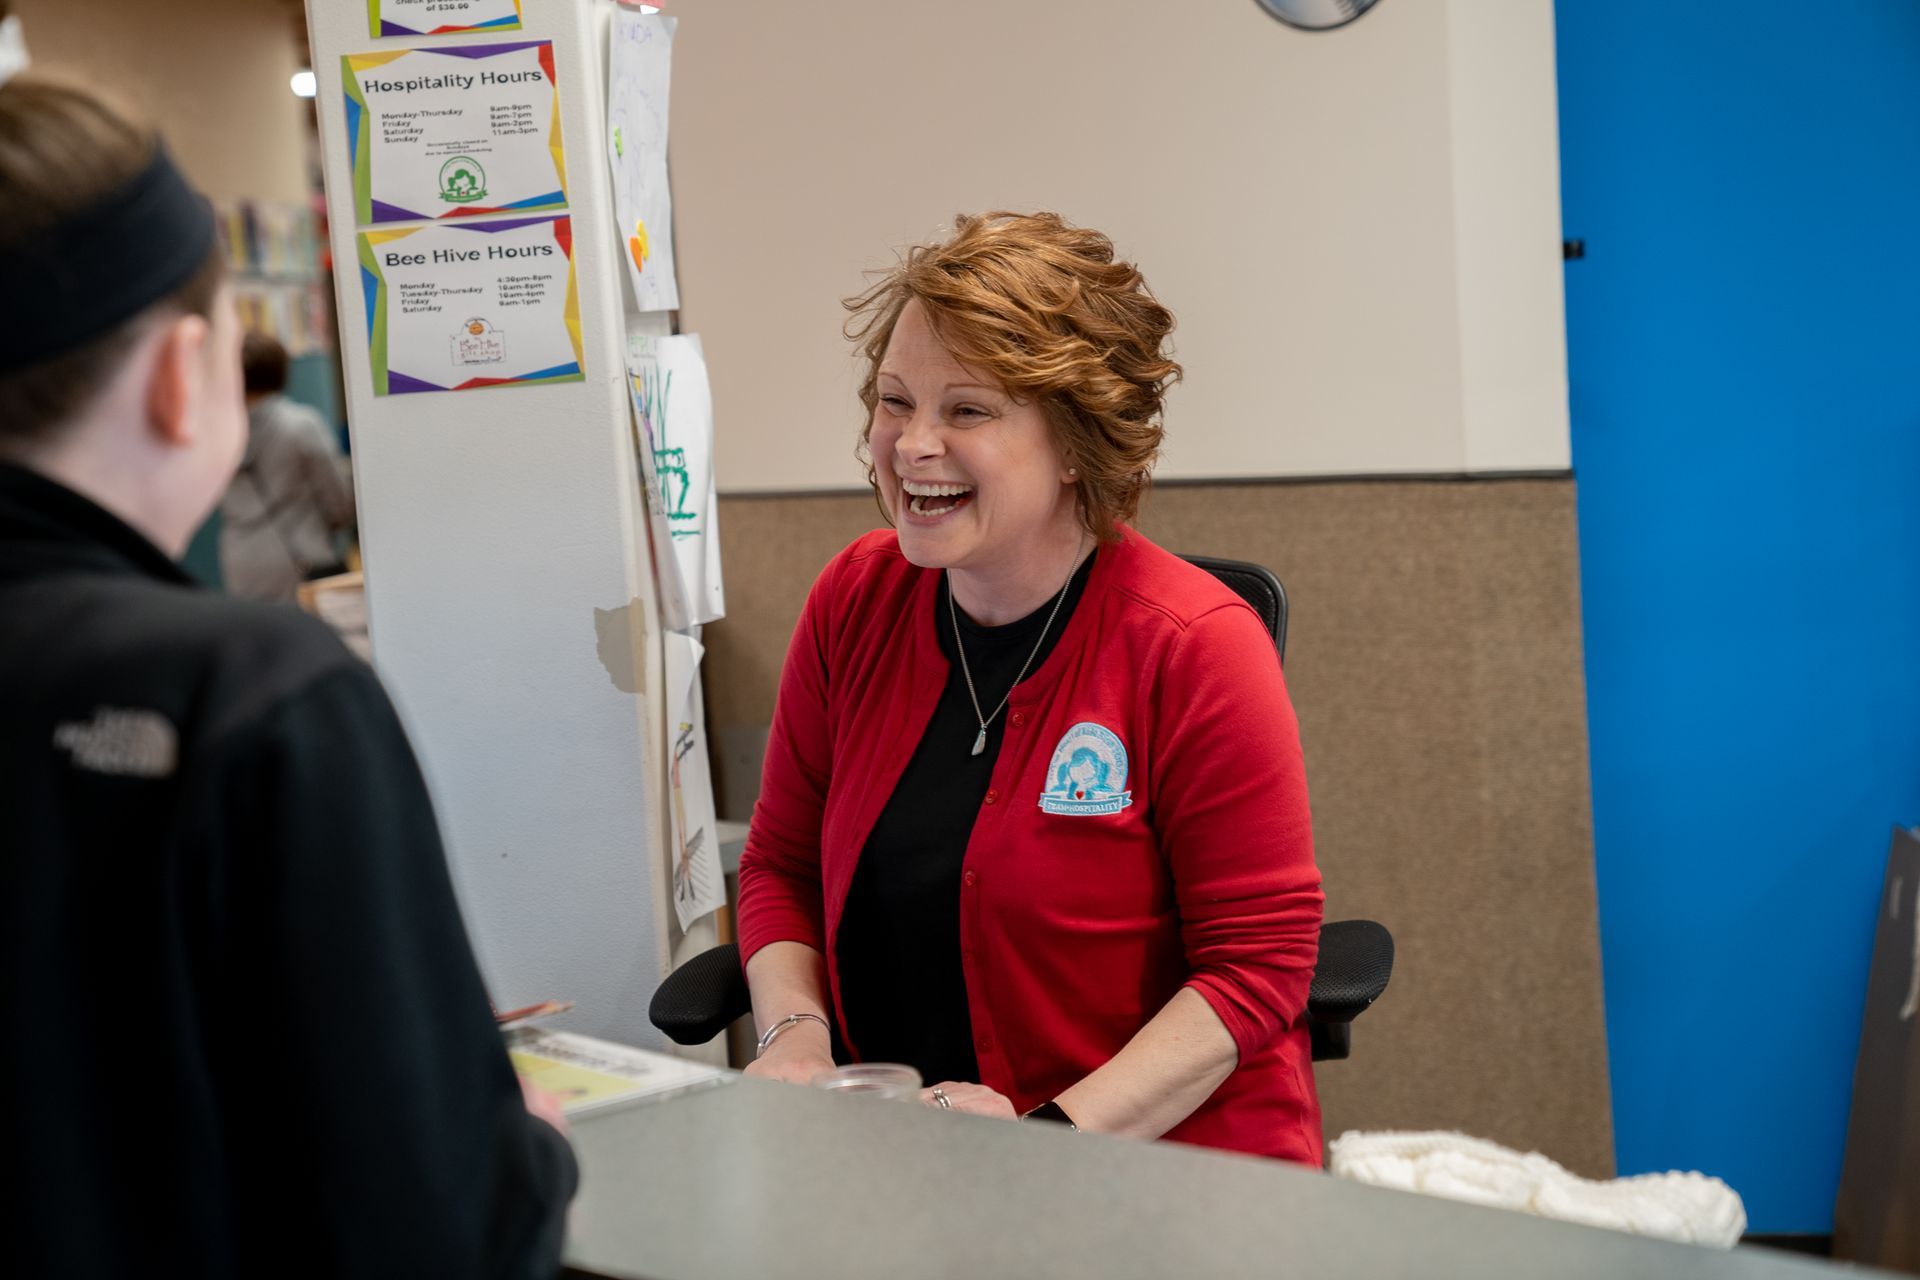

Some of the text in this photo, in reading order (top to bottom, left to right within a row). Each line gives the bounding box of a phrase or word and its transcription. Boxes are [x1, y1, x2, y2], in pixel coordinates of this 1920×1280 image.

[426, 4, 436, 12] of
[364, 71, 542, 93] Hospitality Hours
[381, 109, 463, 120] Monday-Thursday
[382, 120, 411, 128] Friday
[383, 128, 424, 136] Saturday
[384, 136, 418, 144] Sunday
[385, 244, 553, 267] Bee Hive Hours
[400, 282, 435, 291] Monday
[400, 286, 483, 298] Tuesday-Thursday
[401, 298, 430, 306] Friday
[402, 305, 442, 314] Saturday
